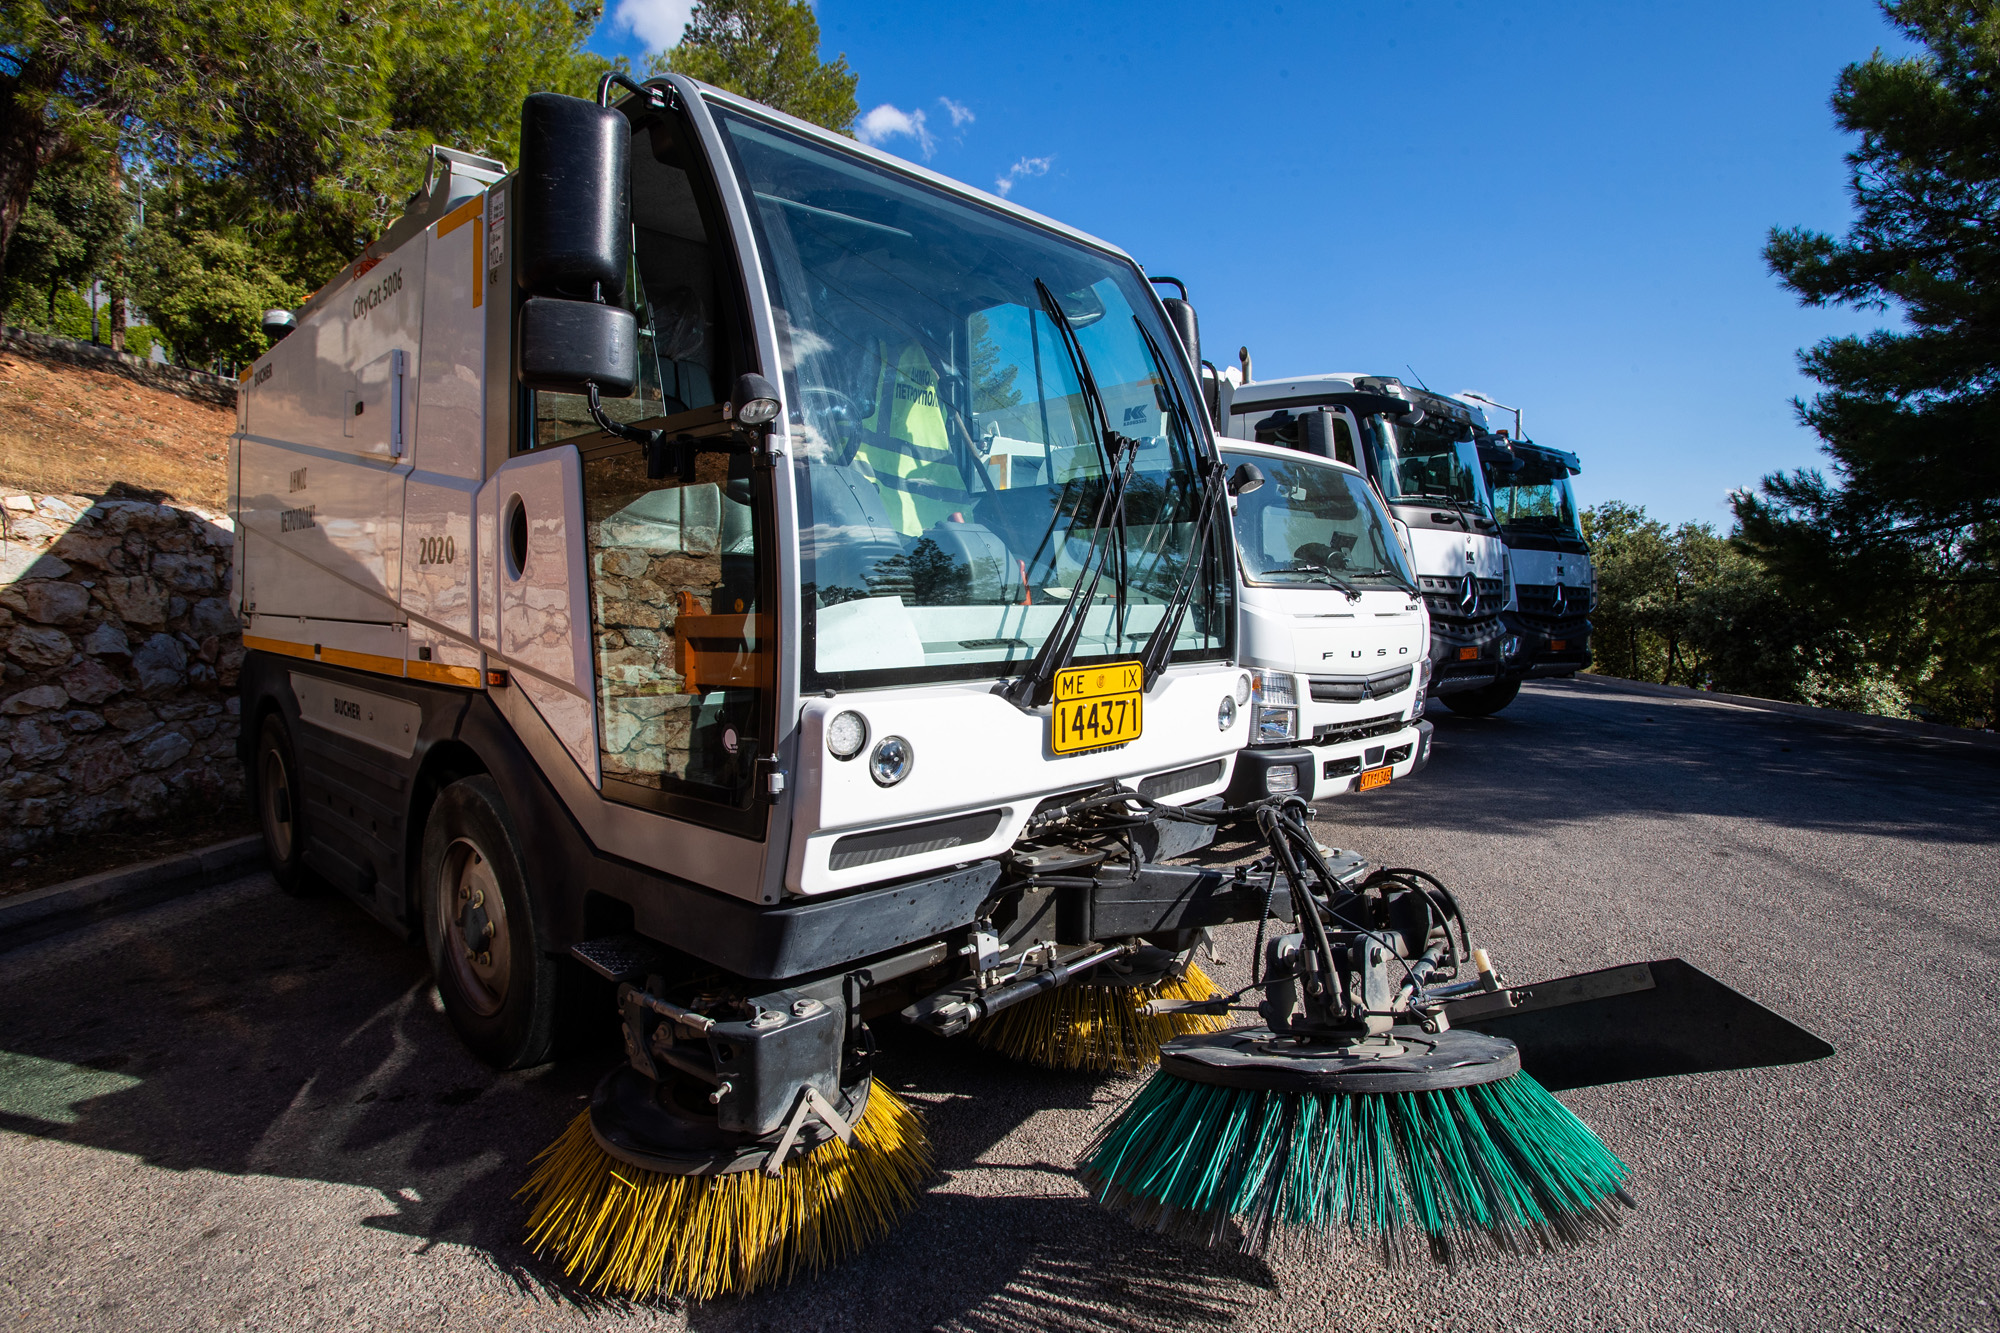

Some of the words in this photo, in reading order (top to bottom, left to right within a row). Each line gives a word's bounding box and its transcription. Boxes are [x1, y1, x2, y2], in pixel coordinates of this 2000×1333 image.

[353, 284, 381, 320] CityCat
[383, 267, 403, 301] 5006
[419, 535, 455, 565] 2020
[1322, 647, 1408, 661] FUSO
[1062, 675, 1085, 696] ME
[1123, 669, 1138, 688] IX
[334, 697, 361, 721] BUCHER
[1060, 698, 1137, 743] 144371
